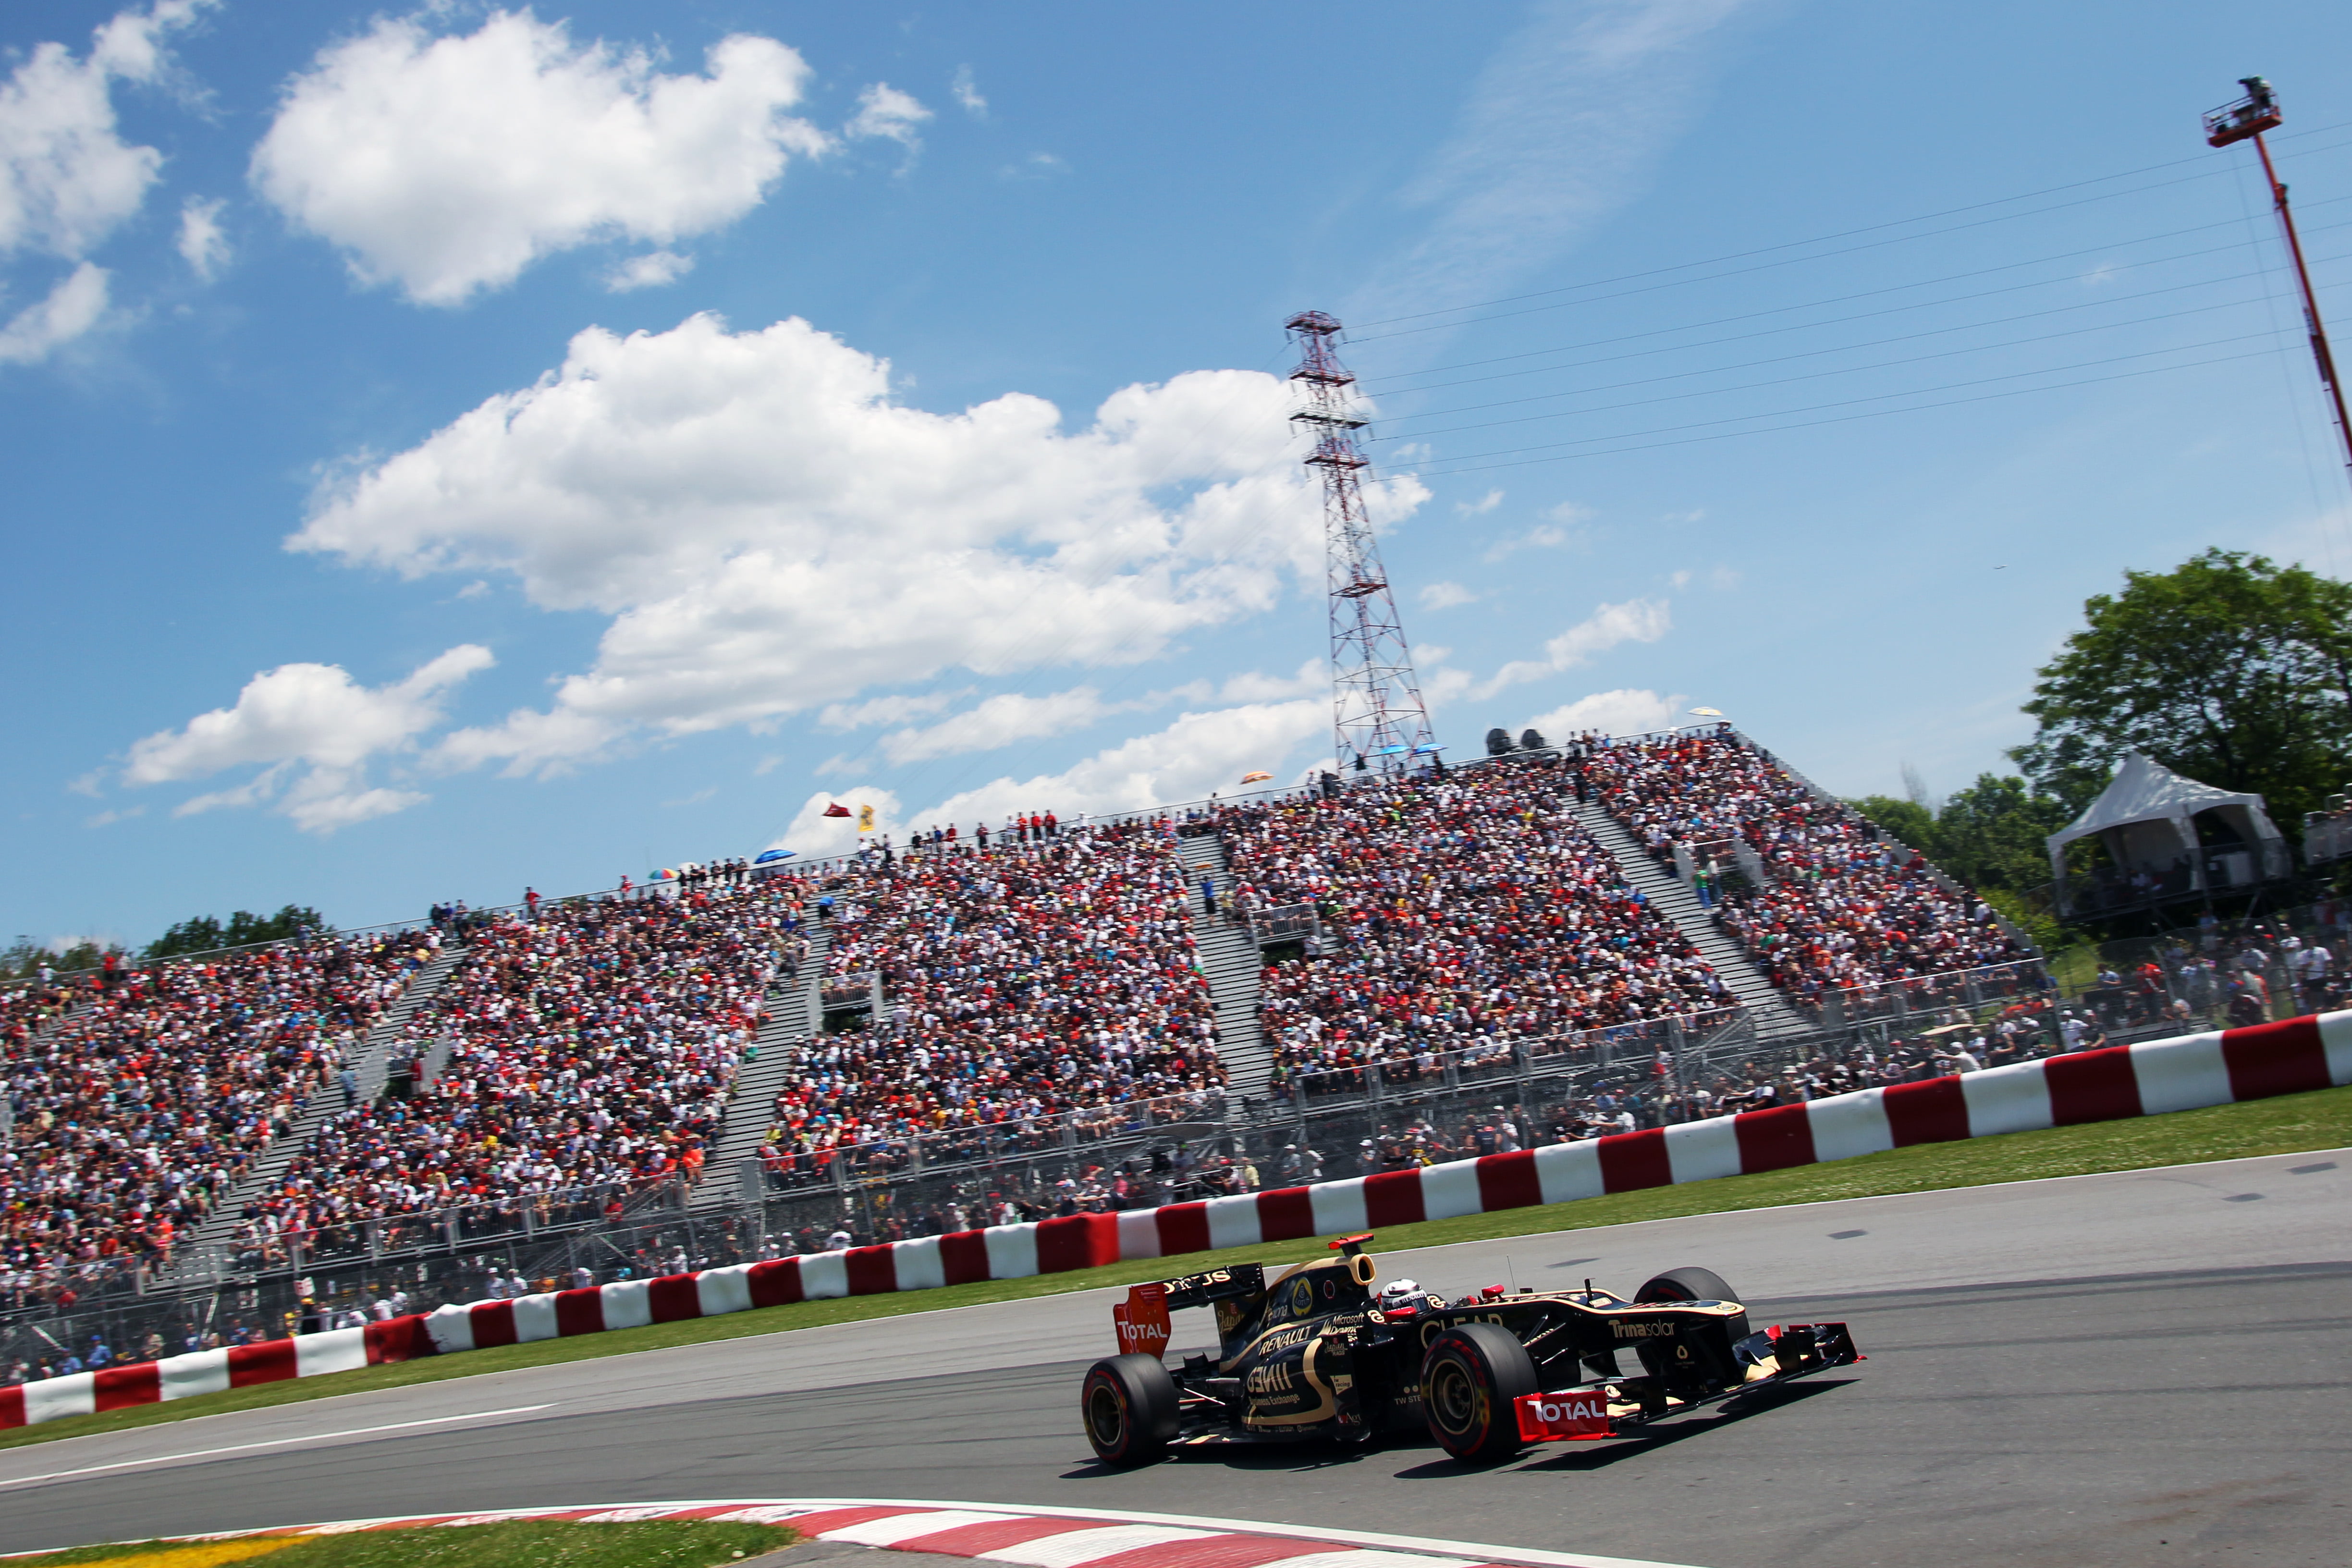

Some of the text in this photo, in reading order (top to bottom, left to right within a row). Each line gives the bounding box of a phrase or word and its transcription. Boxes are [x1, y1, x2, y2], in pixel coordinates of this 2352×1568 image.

[1163, 1271, 1231, 1294] OTUS
[1333, 1312, 1364, 1325] Microsoft
[1117, 1321, 1167, 1339] TOTAL
[1259, 1325, 1314, 1356] RENAULT
[1324, 1341, 1347, 1353] Japan
[1269, 1393, 1300, 1405] Exchange
[1395, 1395, 1421, 1405] TW STE
[1527, 1400, 1605, 1422] TOTAL
